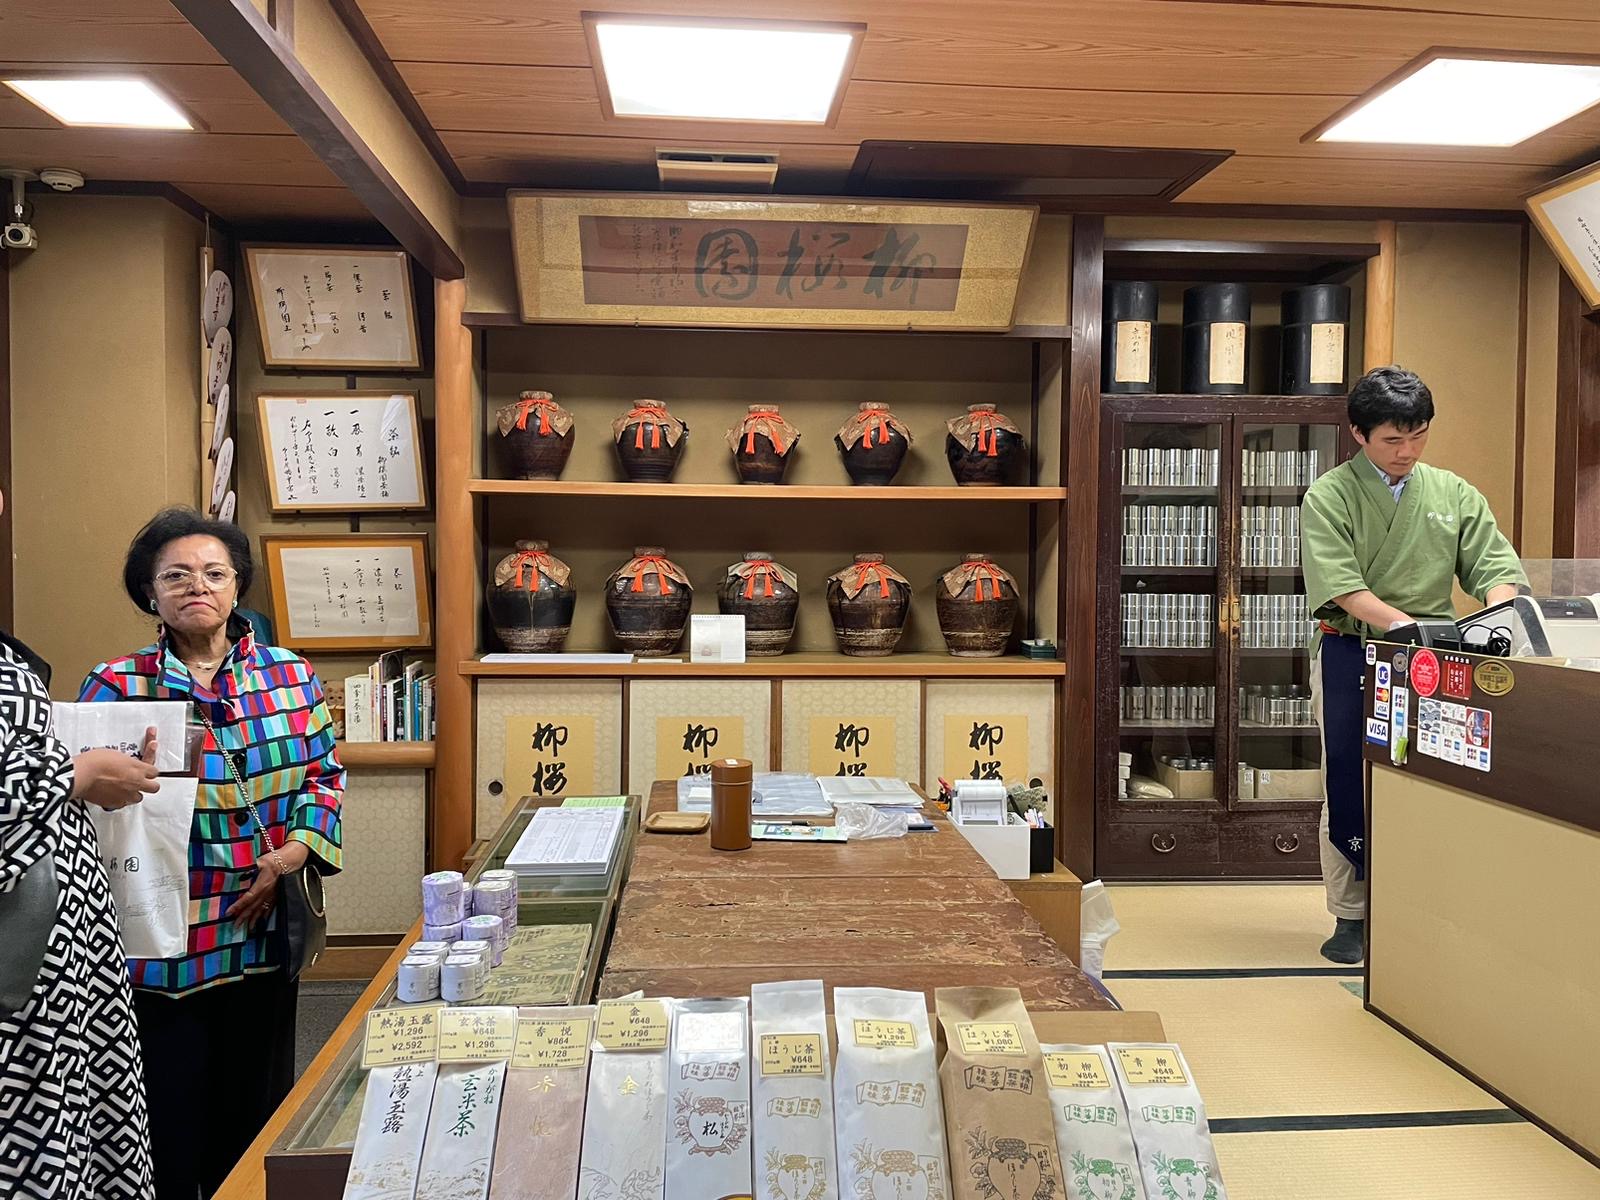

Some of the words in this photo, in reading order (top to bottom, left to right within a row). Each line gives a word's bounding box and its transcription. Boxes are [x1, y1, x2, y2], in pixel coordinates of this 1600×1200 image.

[1369, 722, 1387, 737] VISA
[1347, 836, 1363, 852] 京
[630, 1007, 640, 1016] 金
[380, 1014, 433, 1029] 熱湯玉露
[458, 1017, 497, 1027] 玄米茶
[629, 1017, 650, 1025] ¥648
[393, 1027, 424, 1037] ¥1,296
[861, 1026, 906, 1036] ほうじ茶
[967, 1029, 1012, 1038] ほうじ茶
[392, 1040, 422, 1051] ¥2,592
[465, 1040, 495, 1049] ¥1,296
[547, 1037, 569, 1045] ¥864
[538, 1050, 568, 1058] ¥1,728
[768, 1043, 815, 1055] ほうじ茶
[791, 1055, 813, 1063] ¥648
[617, 1074, 640, 1095] 金
[381, 1066, 412, 1134] 熱湯玉露
[445, 1074, 480, 1138] 玄米茶
[702, 1121, 718, 1136] 松
